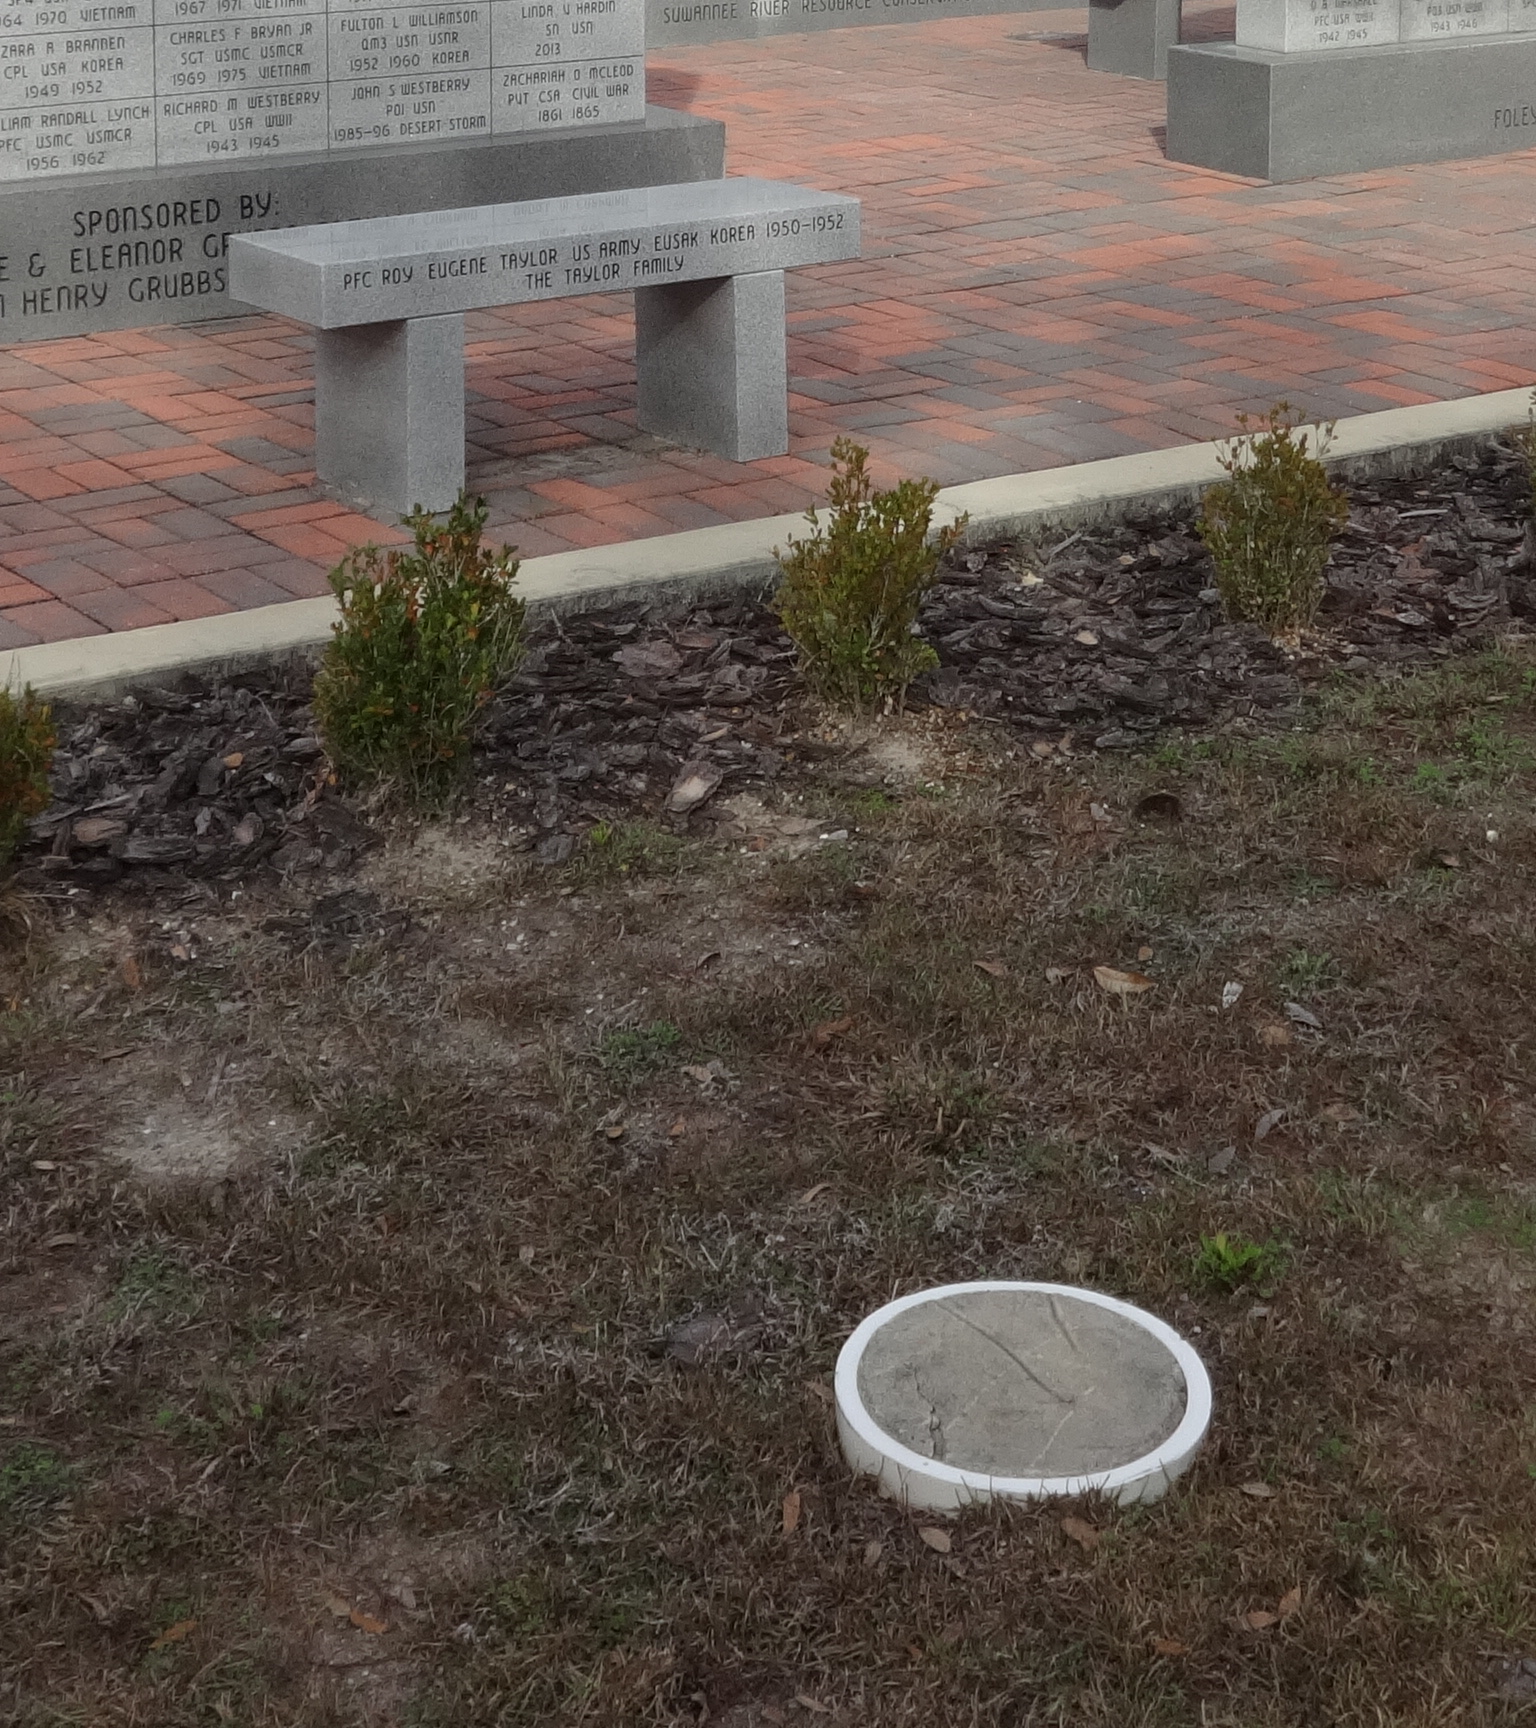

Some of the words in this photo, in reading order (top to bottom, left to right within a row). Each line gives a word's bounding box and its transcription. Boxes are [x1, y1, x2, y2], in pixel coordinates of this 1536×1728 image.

[663, 2, 738, 24] SUWANNEE
[749, 0, 790, 18] RIVER
[503, 69, 565, 87] ZACHARIAH
[589, 64, 634, 80] MCLEOD
[508, 93, 529, 107] PVT
[538, 90, 561, 104] CSA
[572, 87, 600, 101] CIVIL
[606, 84, 629, 98] WAR
[41, 110, 97, 129] RANDALL
[107, 106, 150, 124] LYNCH
[538, 109, 563, 123] 1861
[572, 107, 600, 120] 1865
[36, 133, 74, 150] USMC
[87, 128, 132, 145] USMCR
[26, 156, 60, 171] 1956
[72, 152, 105, 167] 1962
[72, 198, 221, 238] SPONSORED
[239, 192, 280, 221] BY:
[27, 252, 47, 279] &
[69, 238, 183, 275] ELEANOR
[343, 271, 372, 291] PFC
[381, 266, 413, 286] ROY
[428, 256, 487, 281] EUGENE
[500, 248, 558, 272] TAYLOR
[572, 243, 591, 262] US
[598, 236, 641, 260] ARMY
[654, 231, 699, 251] EUSAK
[709, 224, 756, 246] KOREA
[765, 213, 844, 238] 1950-1952
[525, 271, 553, 290] THE
[564, 262, 621, 286] TAYLOR
[633, 254, 685, 276] FAMILY
[21, 282, 109, 314] HENRY
[127, 267, 227, 303] GRUBBS
